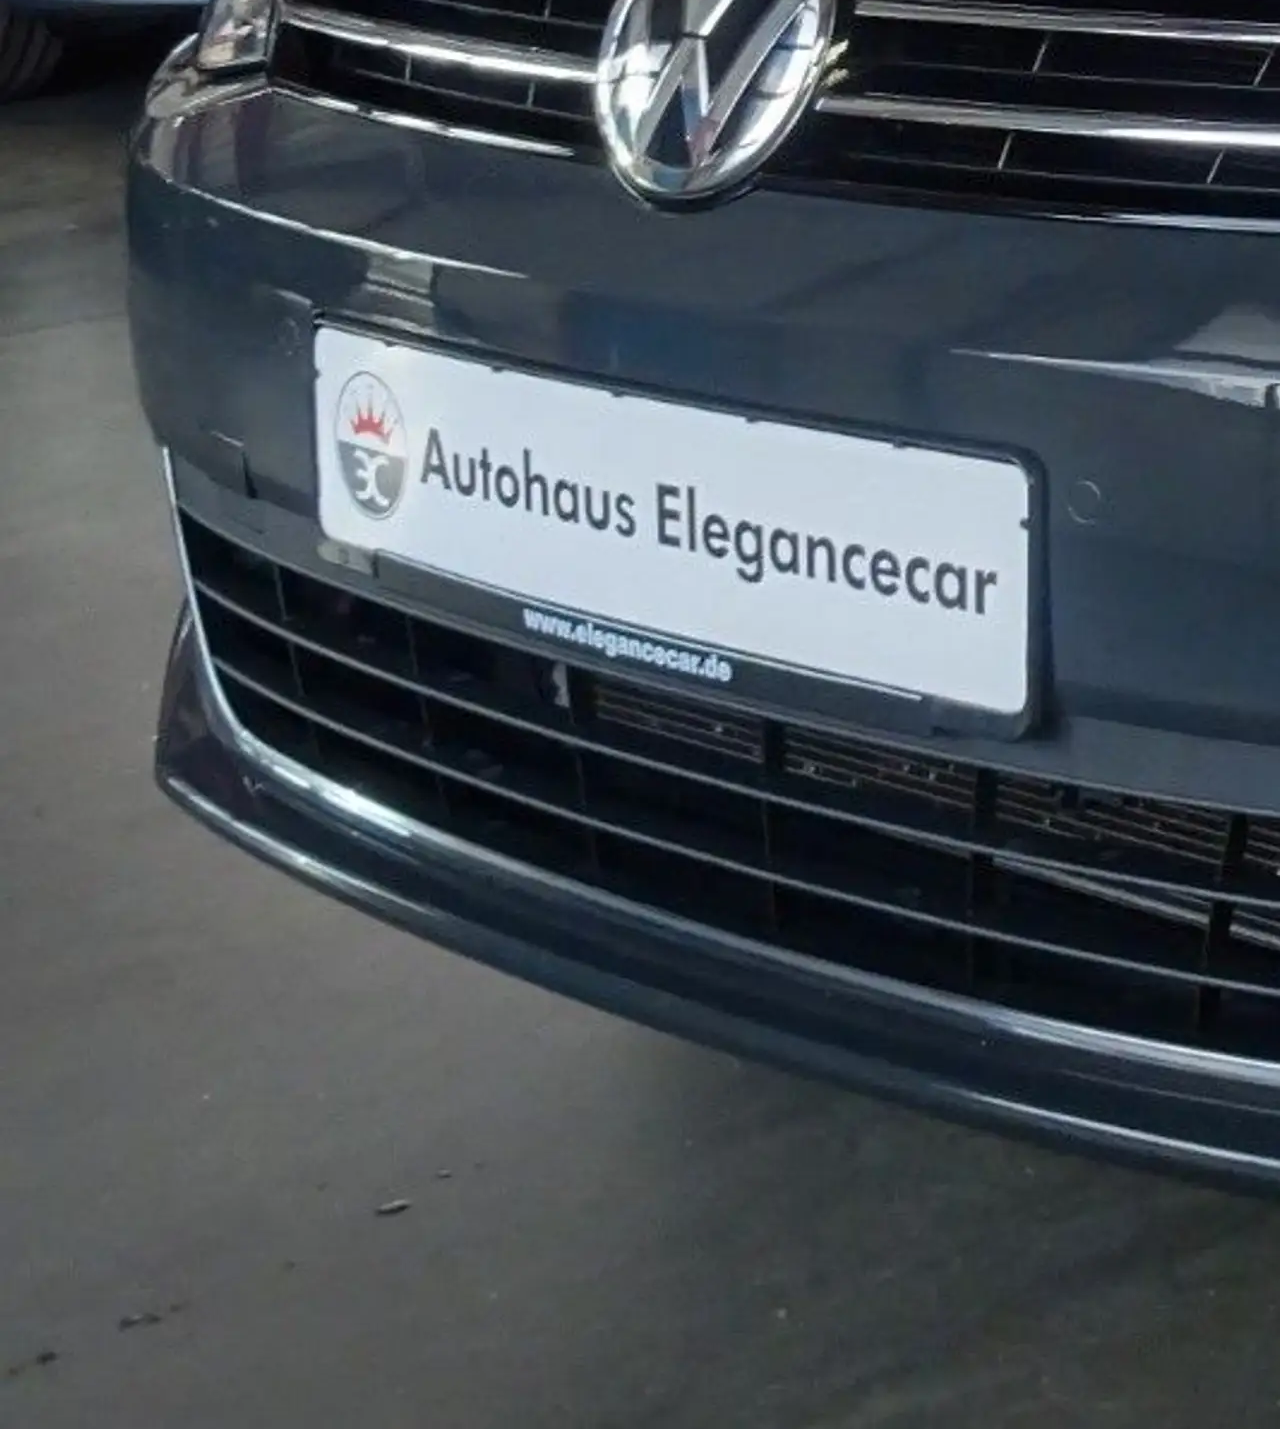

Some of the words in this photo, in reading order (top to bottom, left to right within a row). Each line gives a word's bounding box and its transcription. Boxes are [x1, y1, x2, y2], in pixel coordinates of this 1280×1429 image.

[420, 428, 637, 537] Autohaus
[655, 483, 998, 616] Elegancecar
[522, 607, 733, 683] www.elegancecar.de
